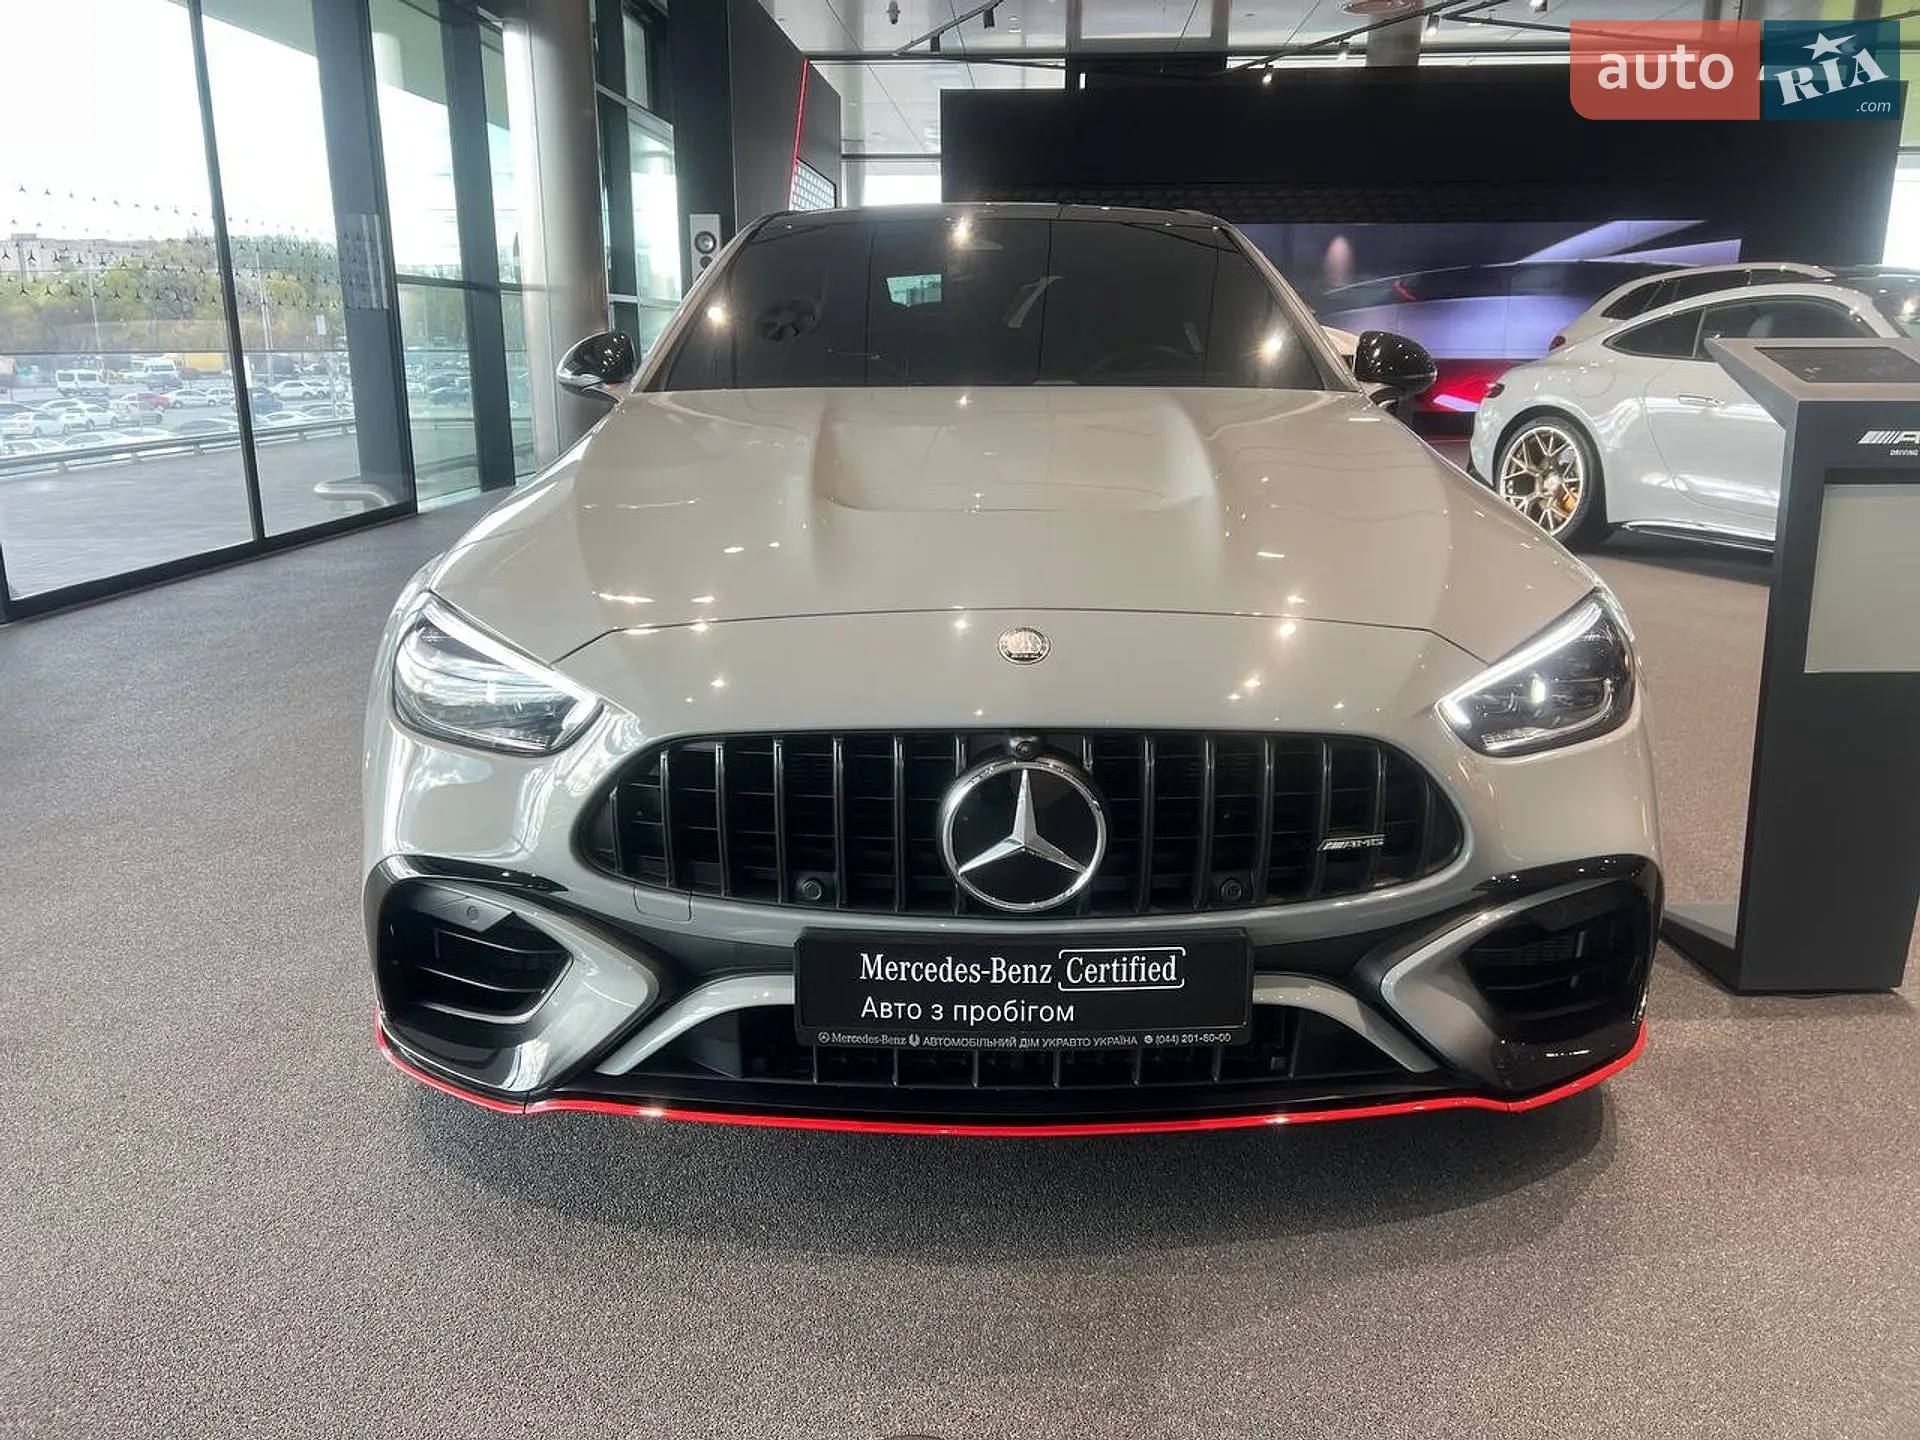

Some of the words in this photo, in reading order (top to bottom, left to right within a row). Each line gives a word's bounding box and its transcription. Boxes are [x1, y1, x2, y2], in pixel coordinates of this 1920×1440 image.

[859, 952, 1053, 985] Mercedes-Benz
[1065, 955, 1177, 984] Certified
[860, 996, 922, 1021] Авто
[931, 1004, 944, 1022] з
[953, 999, 1075, 1027] пробігом
[832, 1032, 907, 1046] Mercedes-Benz
[923, 1036, 1017, 1048] АВТОМОБІЛЬНИЙ
[1019, 1037, 1040, 1049] ДІМ
[1042, 1037, 1091, 1048] УКРАВТО
[1093, 1035, 1138, 1047] УКРАЇНА
[1155, 1034, 1180, 1046] (044)
